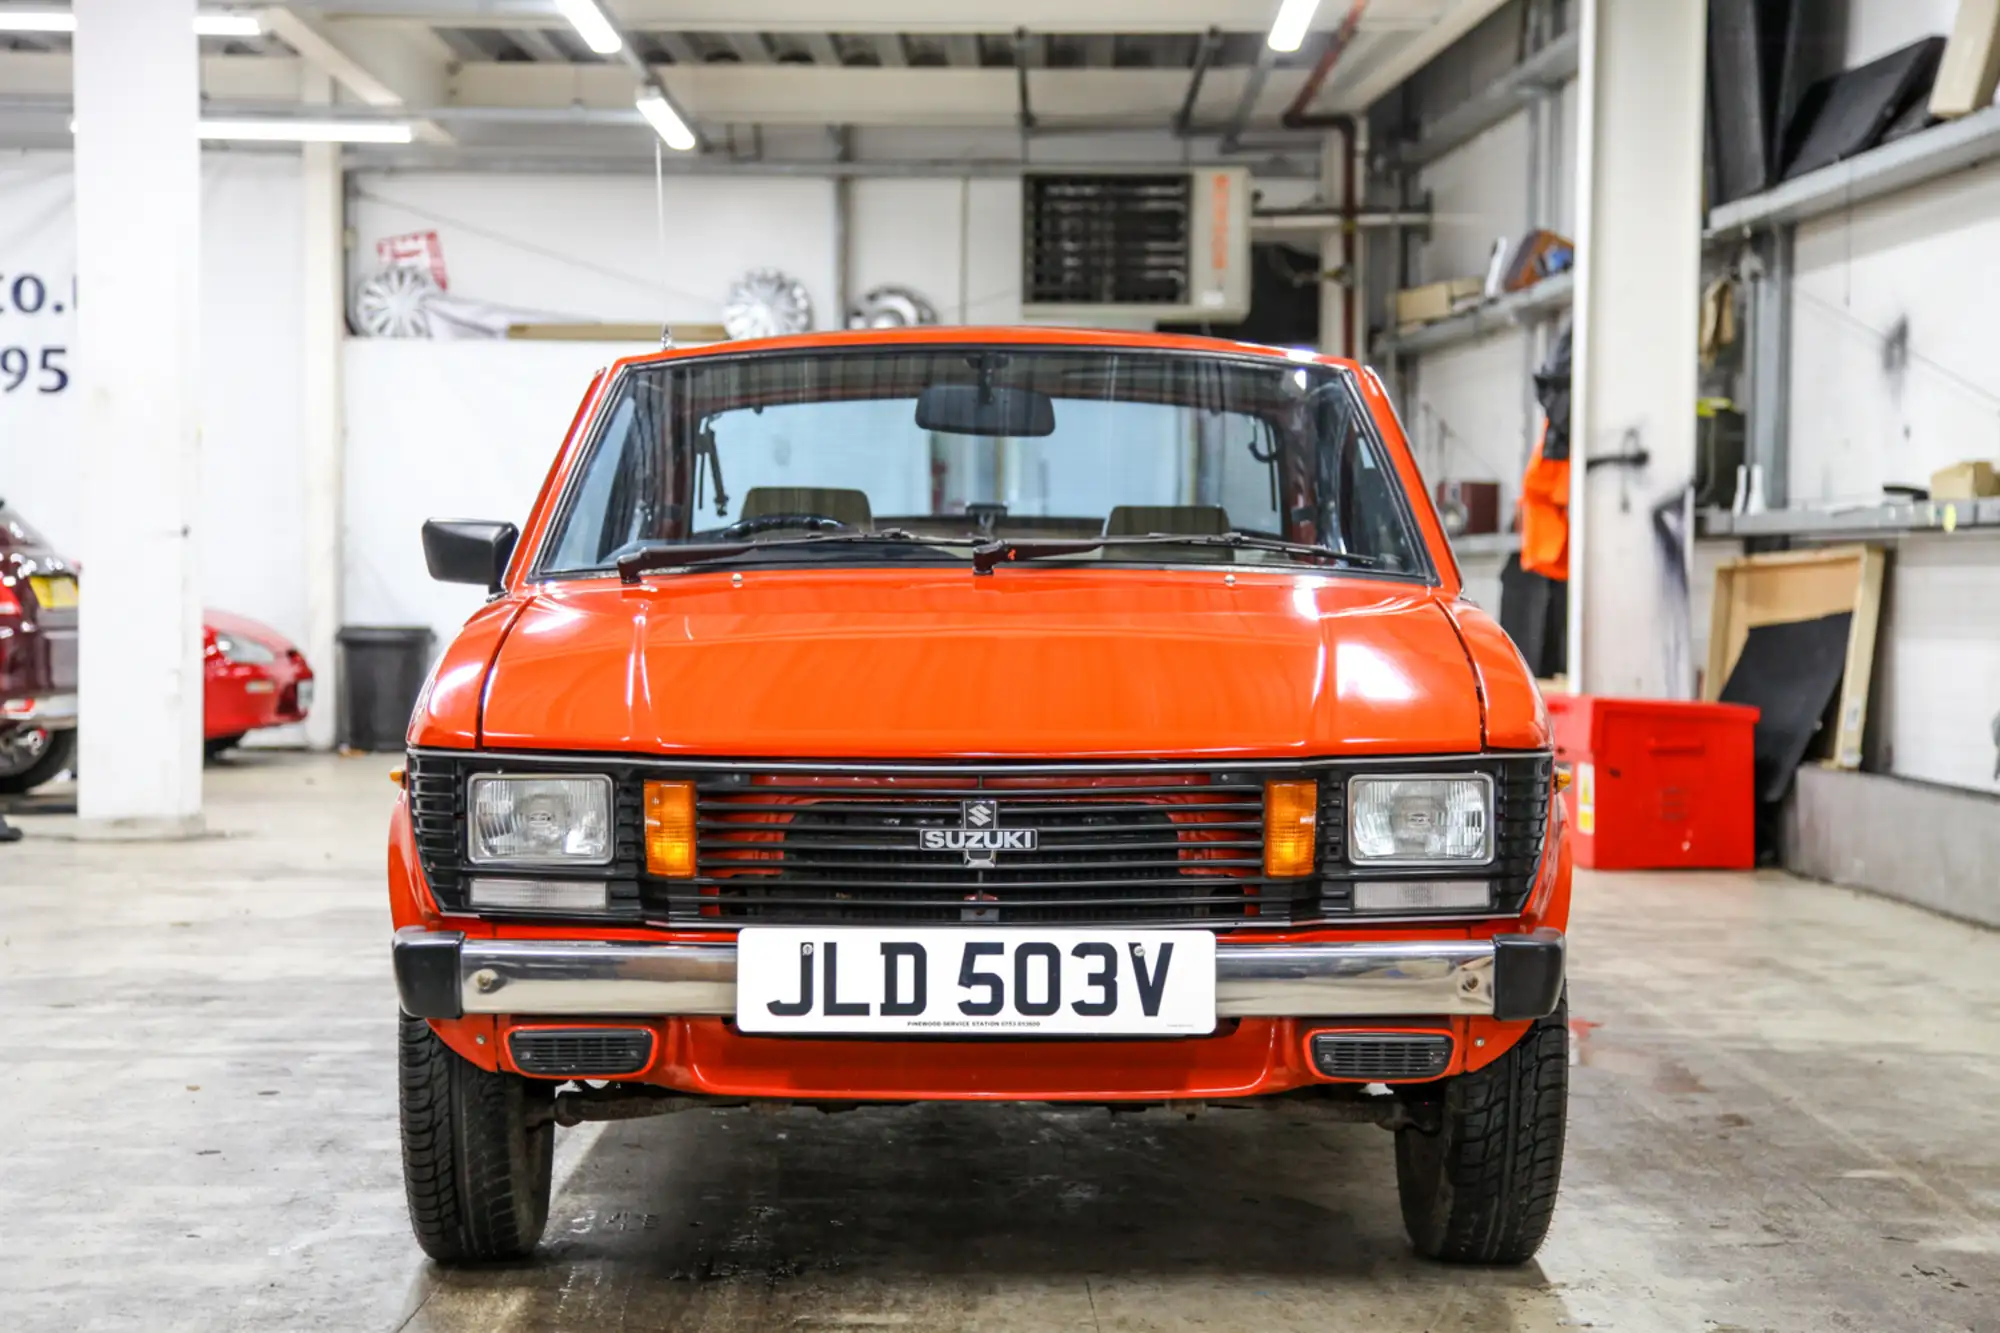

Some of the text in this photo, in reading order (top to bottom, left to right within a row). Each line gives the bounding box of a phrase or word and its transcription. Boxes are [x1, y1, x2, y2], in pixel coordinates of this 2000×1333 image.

[925, 831, 1031, 849] SUZUKI
[767, 942, 1174, 1016] JLD 503V
